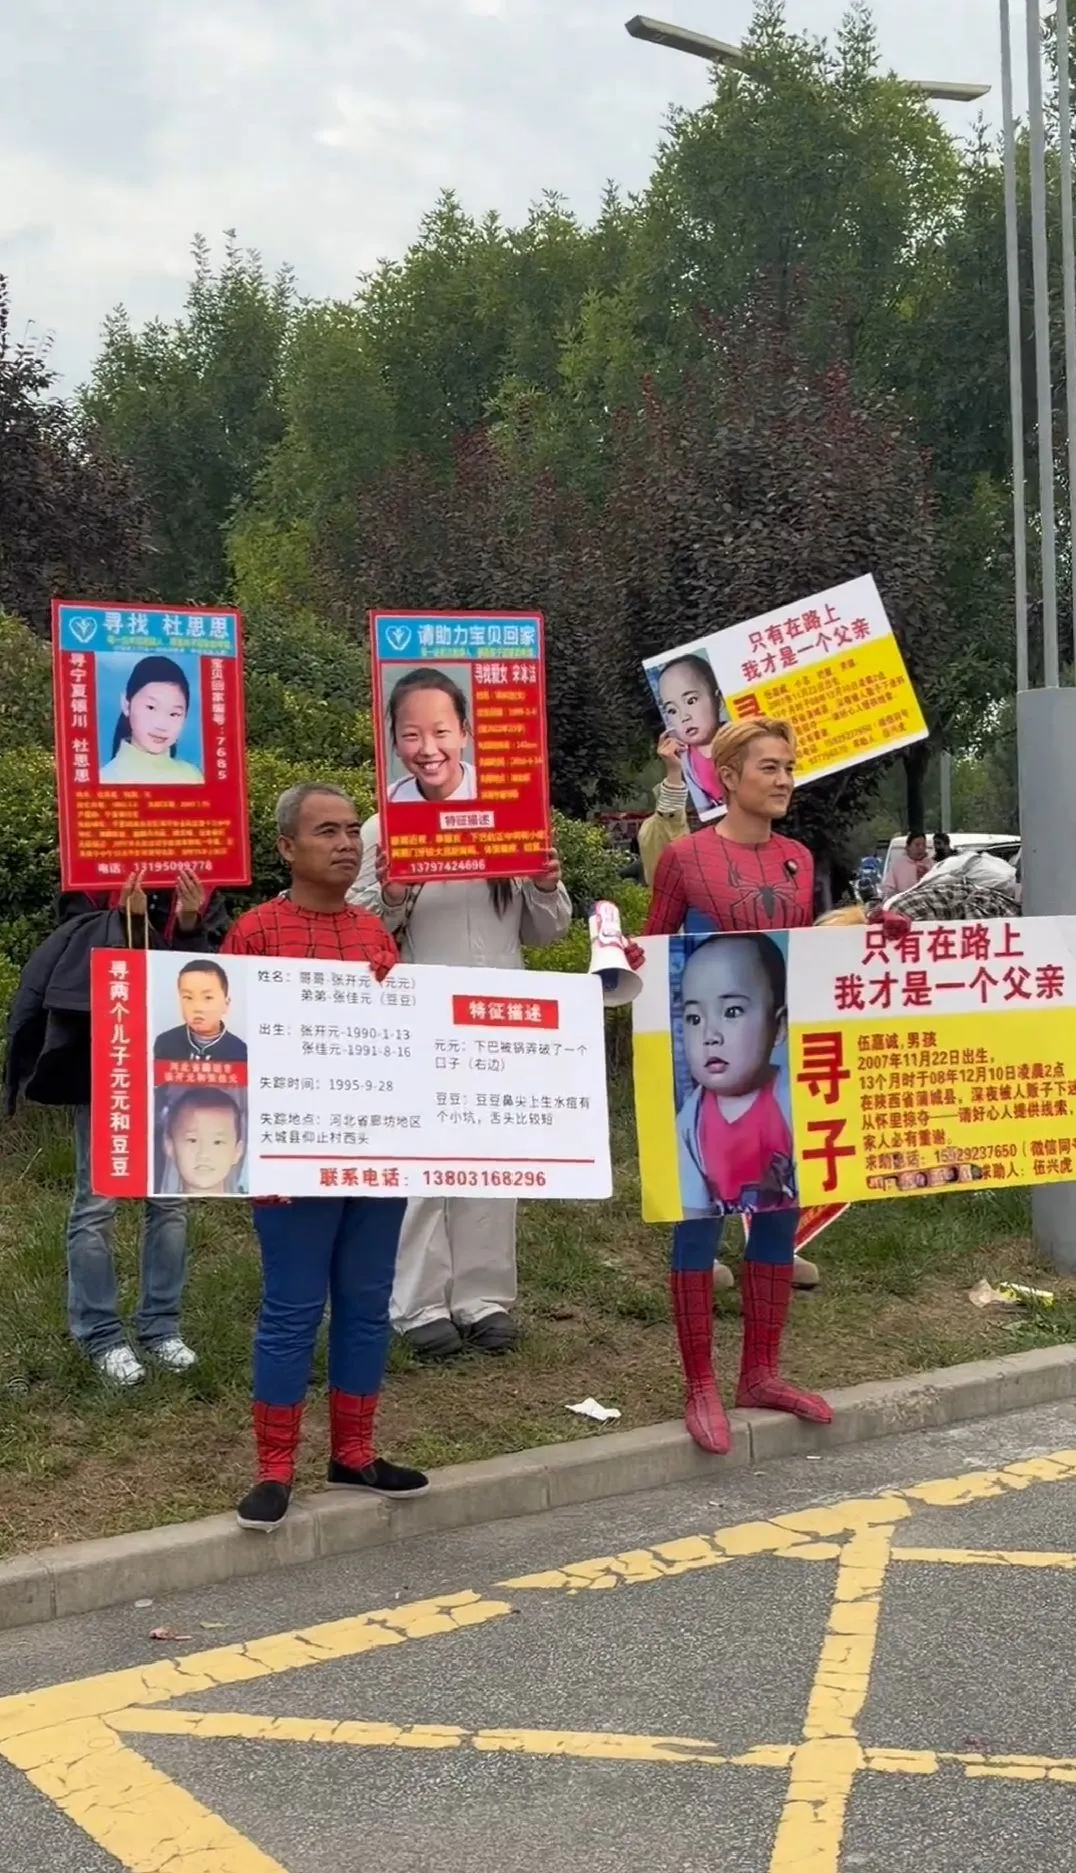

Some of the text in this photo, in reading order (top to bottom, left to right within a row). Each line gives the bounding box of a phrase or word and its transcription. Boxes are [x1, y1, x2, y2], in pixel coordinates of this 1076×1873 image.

[103, 612, 229, 638] 寻找 杜思思
[417, 624, 536, 647] 请助力宝贝回家
[748, 603, 841, 653] 只有在路上
[741, 617, 871, 682] 我才是一个父亲
[862, 922, 1025, 966] 只有在路上
[834, 963, 1065, 1011] 我才是一个父亲
[469, 1001, 542, 1023] 特征描述
[108, 960, 131, 1177] 寻两个儿子元元和豆豆
[435, 1056, 506, 1072] 口子（右边）
[859, 1062, 1065, 1091] 13个月时于08年12月10日凌晨2点
[797, 1031, 856, 1192] 寻子
[319, 1167, 547, 1187] 联系电话：13803168296
